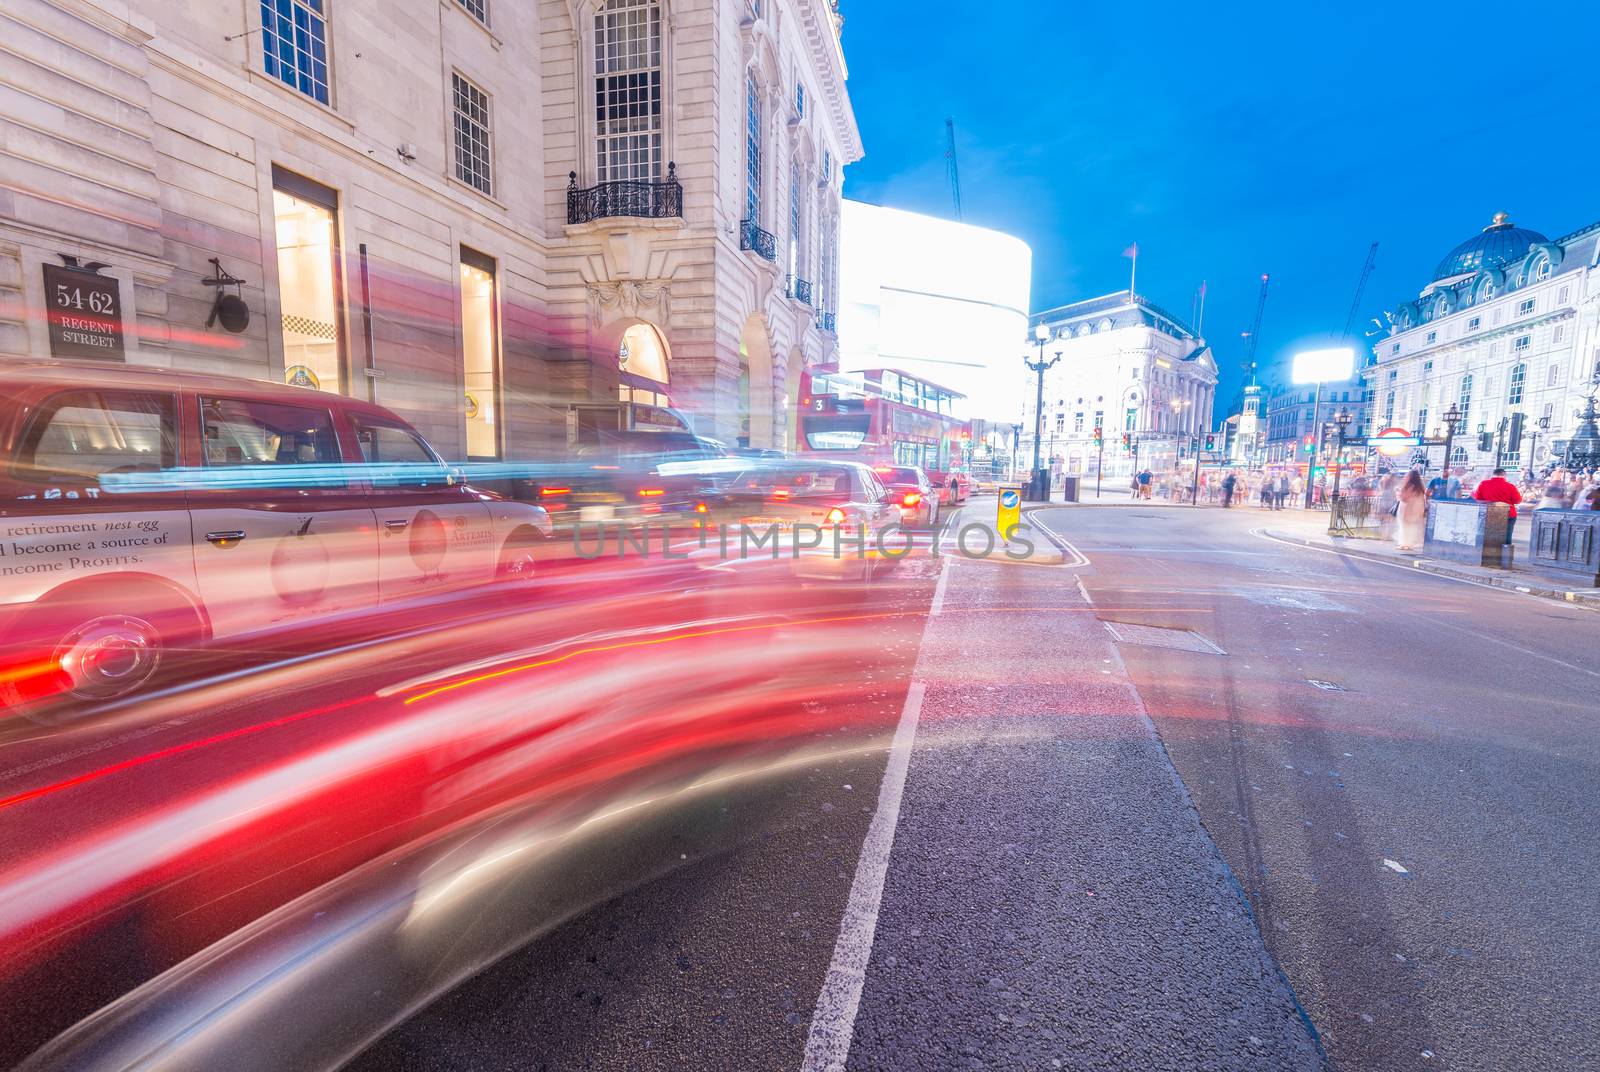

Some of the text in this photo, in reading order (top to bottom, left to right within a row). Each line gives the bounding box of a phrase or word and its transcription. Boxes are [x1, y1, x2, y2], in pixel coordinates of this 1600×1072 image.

[57, 284, 114, 316] 54-62
[61, 316, 114, 335] REGENT
[63, 331, 115, 348] STREET
[815, 399, 823, 411] 3
[7, 519, 160, 537] retirement nest egg
[12, 542, 82, 556] become
[87, 540, 96, 550] a
[101, 537, 150, 549] source
[153, 532, 169, 545] of
[0, 562, 63, 577] ncome
